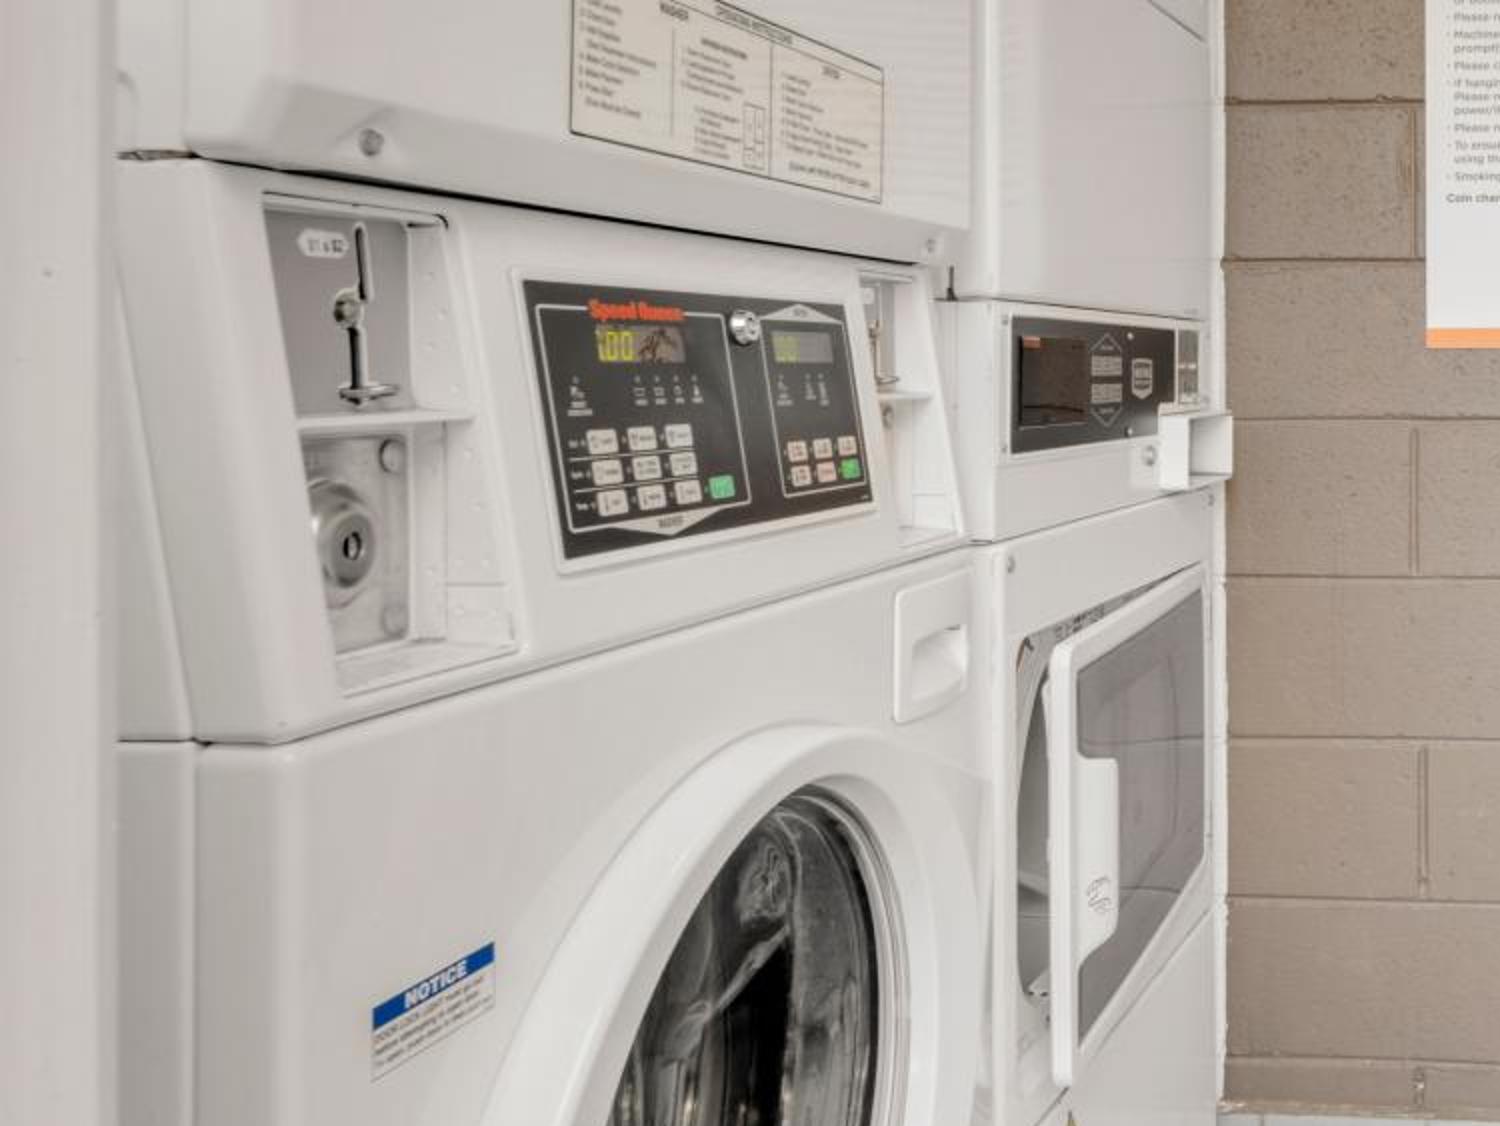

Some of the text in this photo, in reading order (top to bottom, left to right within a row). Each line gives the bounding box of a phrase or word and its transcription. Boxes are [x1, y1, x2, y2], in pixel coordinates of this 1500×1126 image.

[1454, 12, 1489, 21] Please
[1454, 61, 1489, 70] Please
[1454, 92, 1489, 100] Please
[1454, 123, 1489, 132] Please
[1455, 140, 1468, 149] To
[1454, 155, 1484, 164] using
[1446, 193, 1473, 203] Coin
[588, 299, 635, 321] Speed
[404, 959, 468, 1009] NOTICE
